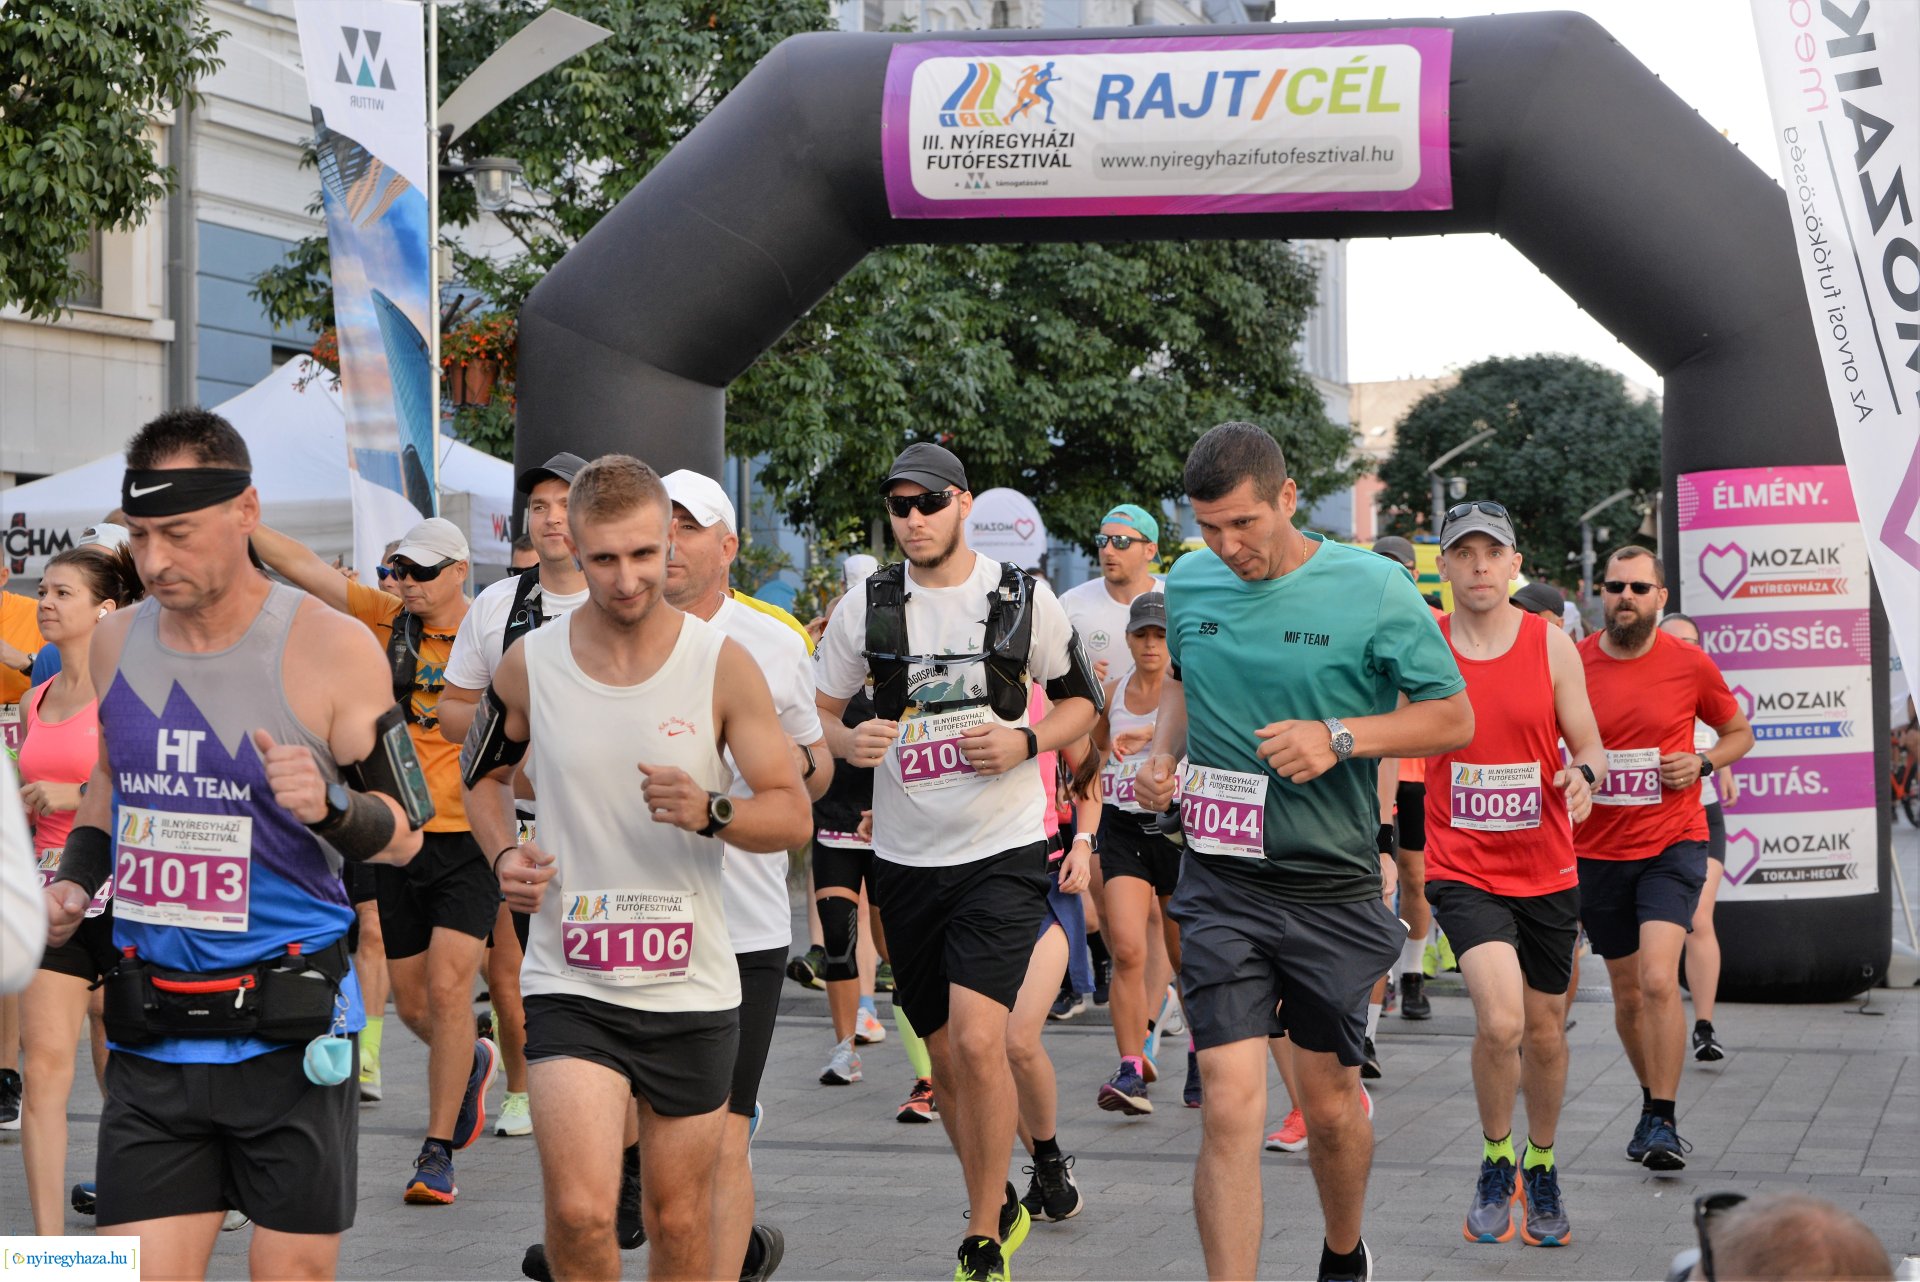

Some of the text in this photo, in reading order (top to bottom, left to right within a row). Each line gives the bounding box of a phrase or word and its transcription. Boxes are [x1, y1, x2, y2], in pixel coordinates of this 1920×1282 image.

[1092, 55, 1401, 121] RAJT/CÉL
[922, 129, 1075, 150] III. NYÍREGYHÁZI
[927, 150, 1072, 170] FUTÓFESZTIVÁL
[1100, 145, 1395, 170] www.nyiregyhazifutofesztival.hu
[1713, 477, 1828, 510] ÉLMÉNY.
[1750, 547, 1840, 567] MOZAIK
[1817, 566, 1842, 576] med
[1749, 579, 1829, 594] NYÍREGYHÁZA
[1284, 631, 1330, 646] MIF TEAM
[1703, 620, 1849, 655] KÖZÖSSÉG.
[1757, 690, 1846, 711] MOZAIK
[1757, 725, 1831, 738] DEBRECEN
[120, 773, 251, 801] HANKA TEAM
[1735, 766, 1829, 797] FUTÁS.
[1455, 791, 1538, 817] 10084
[1182, 799, 1260, 839] 21044
[1762, 833, 1850, 854] MOZAIK
[118, 852, 243, 902] 21013
[1762, 867, 1839, 881] TOKAJI-HEGY
[566, 927, 688, 962] 21106
